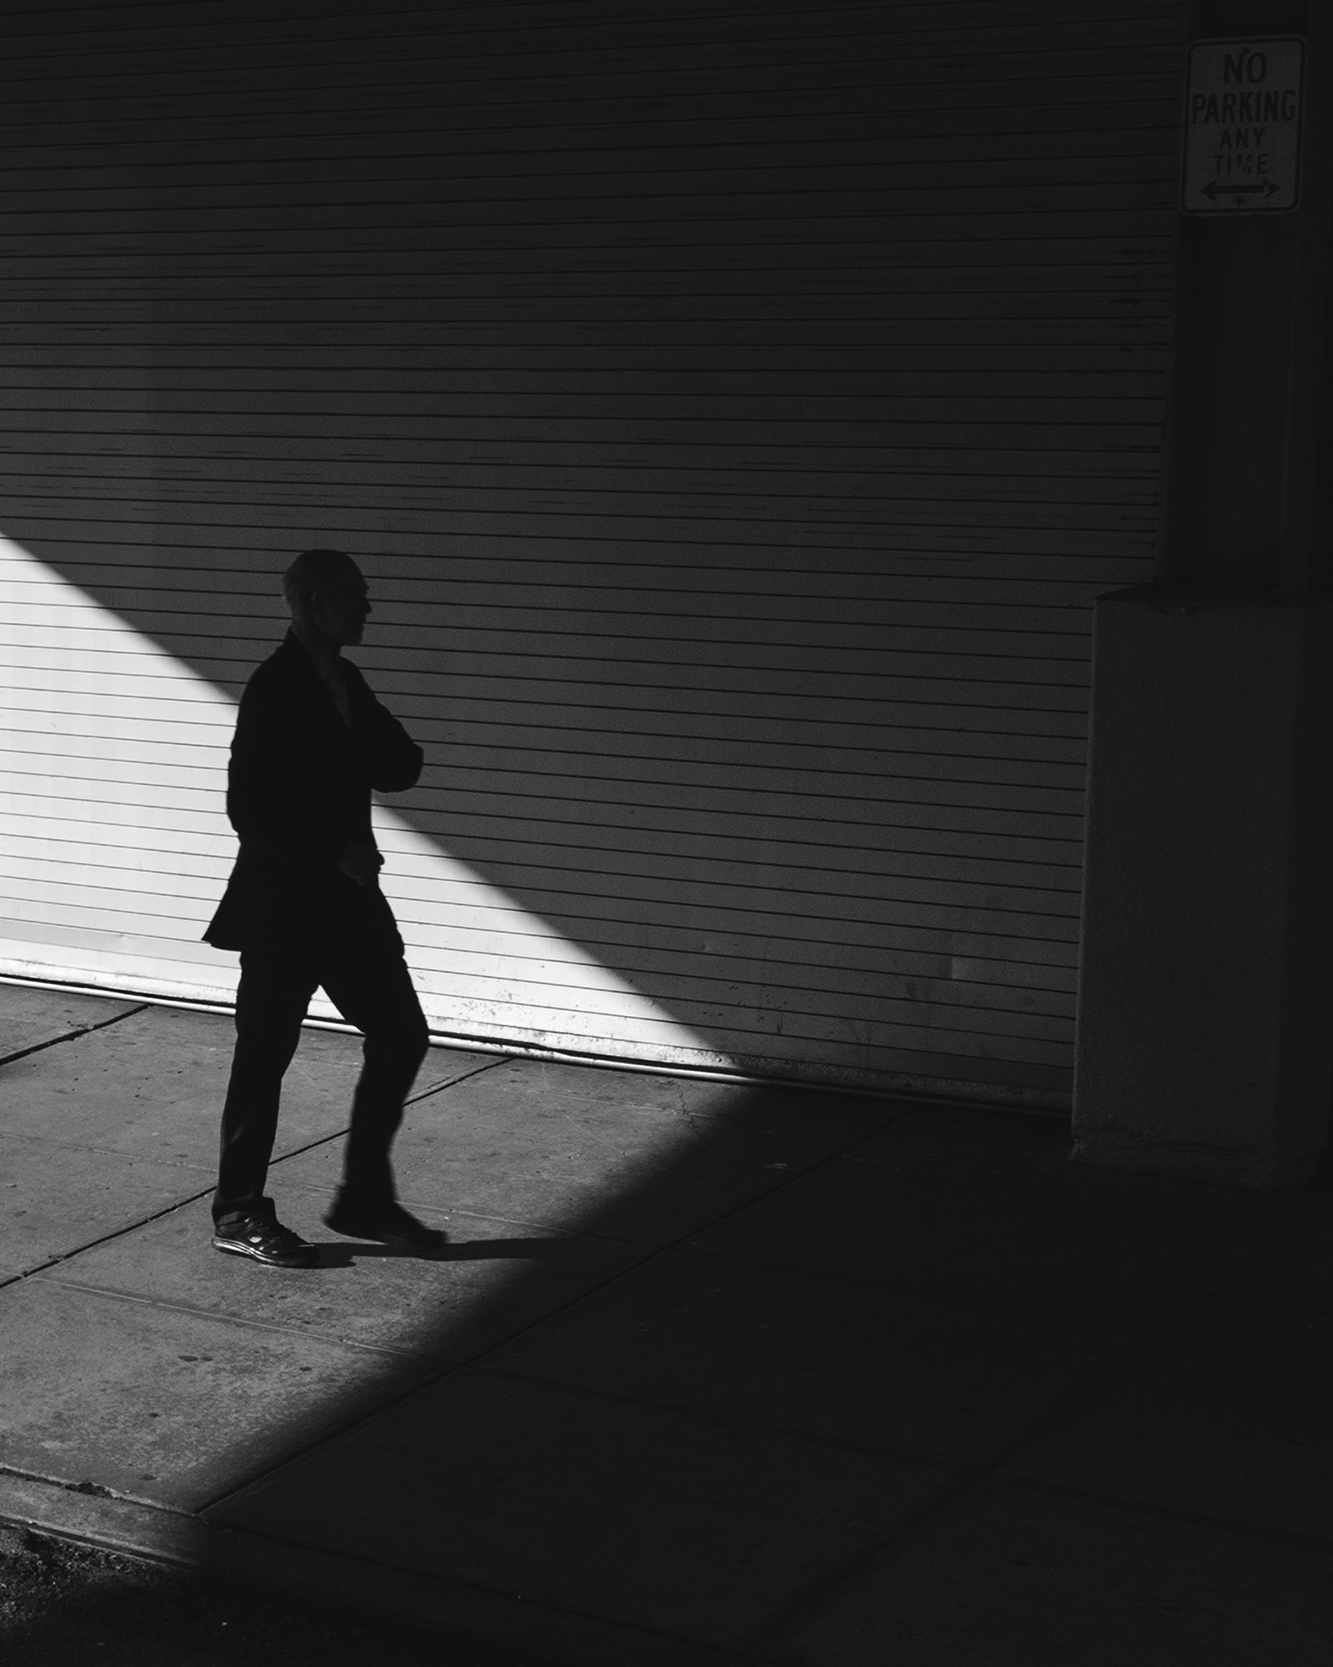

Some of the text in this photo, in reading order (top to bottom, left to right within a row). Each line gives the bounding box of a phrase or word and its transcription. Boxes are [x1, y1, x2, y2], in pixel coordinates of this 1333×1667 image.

[1223, 52, 1267, 85] NO
[1191, 89, 1296, 125] PARKING
[1219, 127, 1266, 150] ANY
[1213, 153, 1270, 176] TIME
